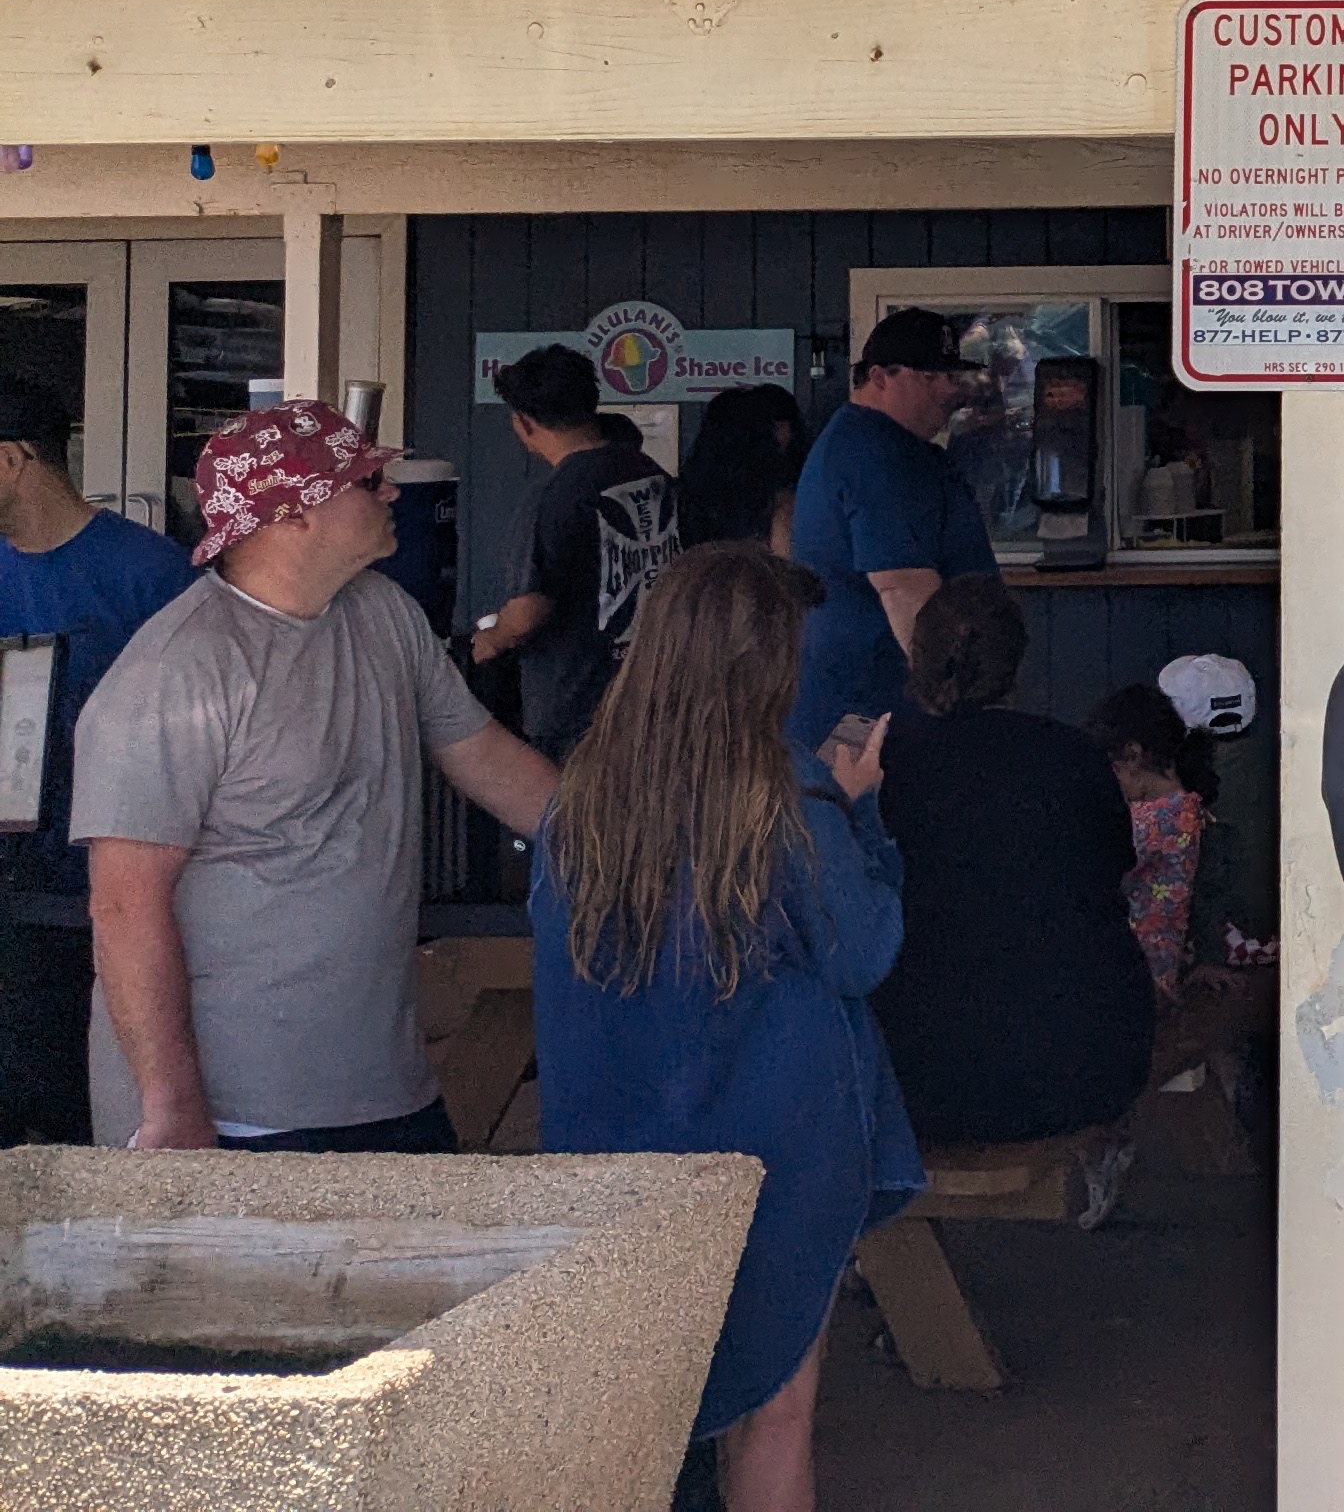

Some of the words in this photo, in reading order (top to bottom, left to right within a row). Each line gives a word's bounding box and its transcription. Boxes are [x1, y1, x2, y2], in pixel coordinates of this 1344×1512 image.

[1199, 168, 1221, 184] NO
[1230, 168, 1329, 184] OVERNIGHT
[1204, 203, 1288, 217] VIOLATORS
[1294, 203, 1328, 217] WILL
[1193, 225, 1211, 239] AT
[1235, 260, 1284, 273] TOWED
[1199, 280, 1264, 301] 808
[1252, 309, 1287, 324] blow
[1293, 311, 1310, 324] it,
[1316, 314, 1336, 323] we
[588, 309, 680, 348] ULULANI'S
[1193, 330, 1302, 343] 877-HELP
[674, 356, 747, 378] Shave
[754, 356, 789, 377] Ice
[1264, 363, 1284, 372] HRS
[1289, 363, 1308, 372] SEC
[1315, 363, 1335, 372] 290
